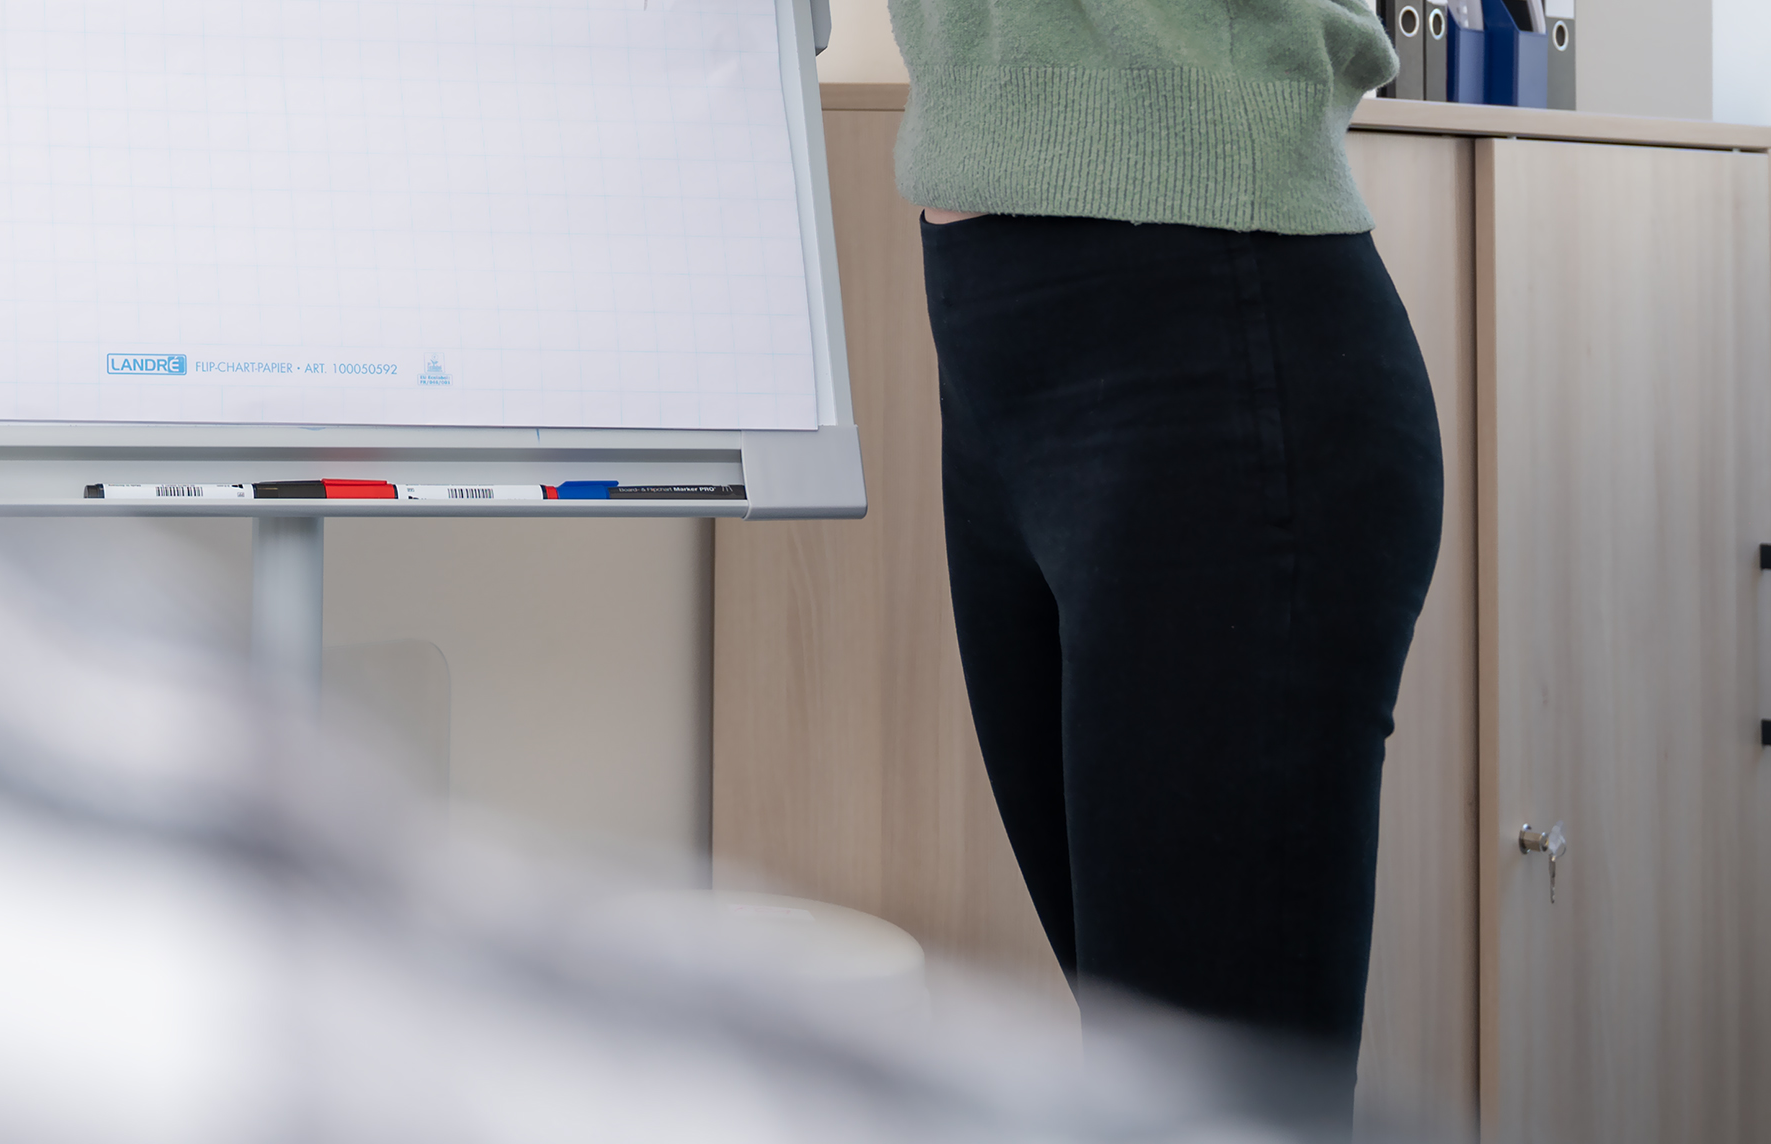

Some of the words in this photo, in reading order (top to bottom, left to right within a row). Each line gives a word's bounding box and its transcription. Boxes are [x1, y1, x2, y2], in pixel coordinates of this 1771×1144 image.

[109, 355, 185, 374] LANDRÉ
[304, 360, 328, 375] ART.
[332, 362, 398, 376] 100050592
